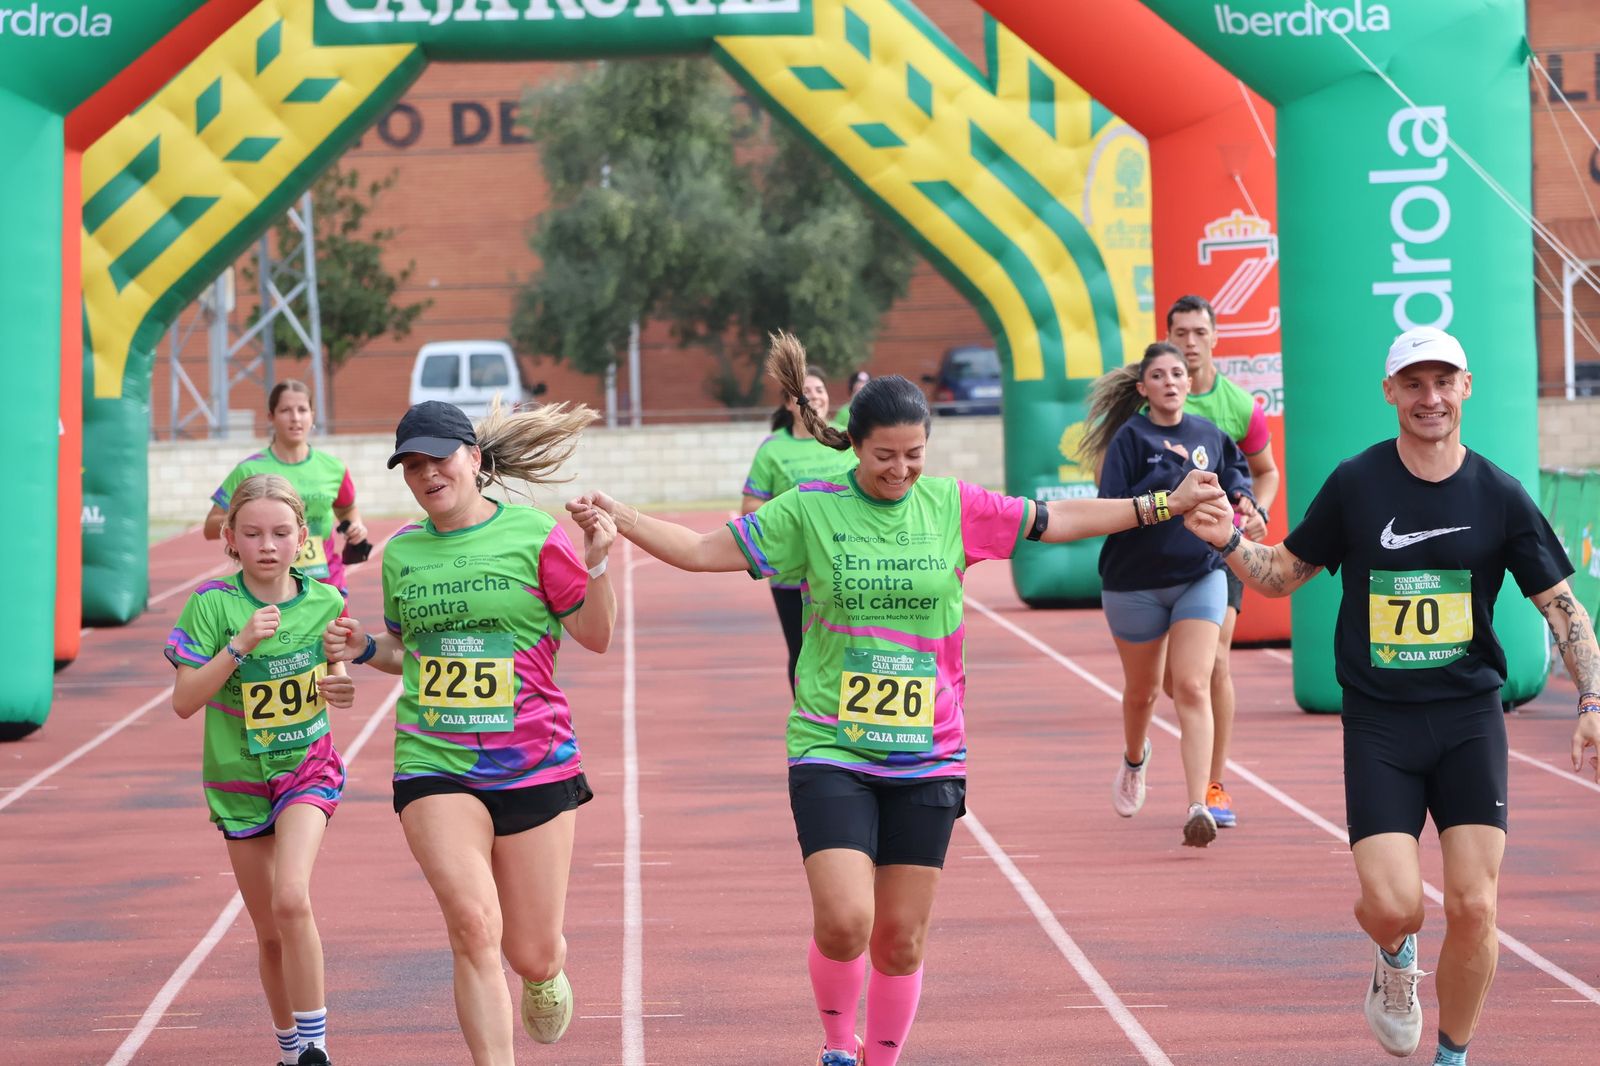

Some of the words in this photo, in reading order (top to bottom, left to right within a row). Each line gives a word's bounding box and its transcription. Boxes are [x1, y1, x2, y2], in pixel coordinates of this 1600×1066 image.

[1214, 0, 1391, 36] Iberdrola
[847, 535, 886, 544] Iberdrola
[846, 554, 870, 570] En
[877, 555, 947, 571] marcha
[407, 584, 427, 600] En
[433, 574, 510, 596] marcha
[833, 554, 843, 609] ZAMORA
[845, 575, 913, 591] contra
[1415, 581, 1441, 590] RURAL
[409, 599, 469, 620] contra
[846, 594, 865, 610] el
[870, 594, 939, 610] cáncer
[1388, 598, 1440, 635] 70
[1398, 651, 1427, 661] CAJA
[270, 665, 288, 675] CAJA
[289, 658, 311, 671] RURAL
[872, 661, 890, 670] CAJA
[892, 663, 914, 671] RURAL
[424, 659, 497, 699] 225
[249, 670, 318, 719] 294
[846, 675, 922, 717] 226
[441, 714, 466, 724] CAJA
[469, 714, 508, 724] RURAL
[278, 730, 305, 742] CAJA
[306, 717, 326, 737] RURAL
[866, 731, 893, 742] CAJA
[896, 733, 928, 743] RURAL
